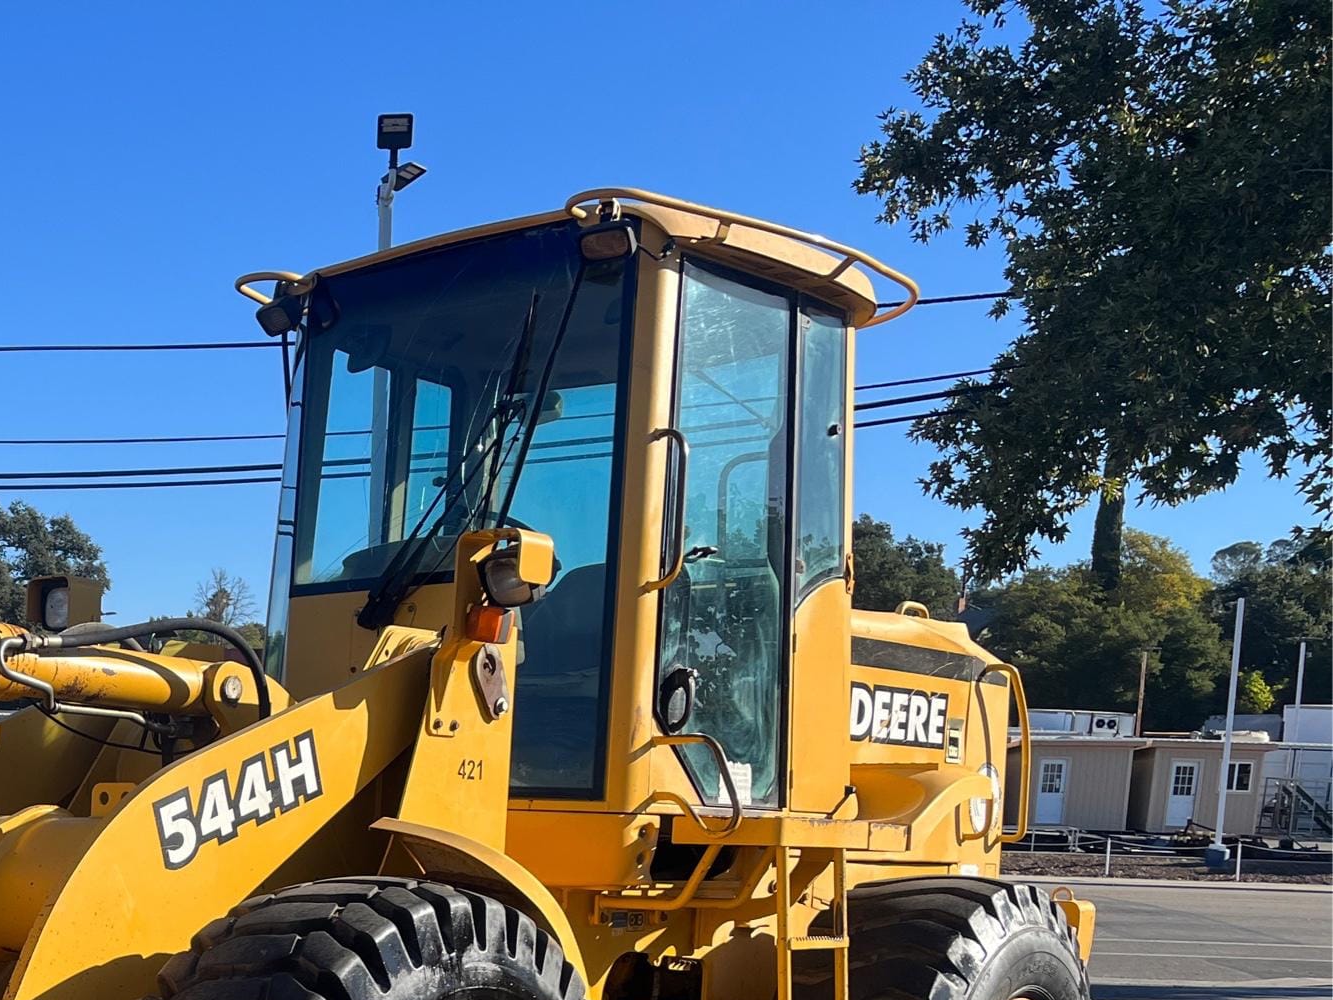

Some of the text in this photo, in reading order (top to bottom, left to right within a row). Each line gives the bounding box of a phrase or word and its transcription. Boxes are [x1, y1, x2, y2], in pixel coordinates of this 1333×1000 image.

[850, 684, 948, 746] DEERE
[155, 733, 321, 867] 544H
[457, 759, 483, 780] 421
